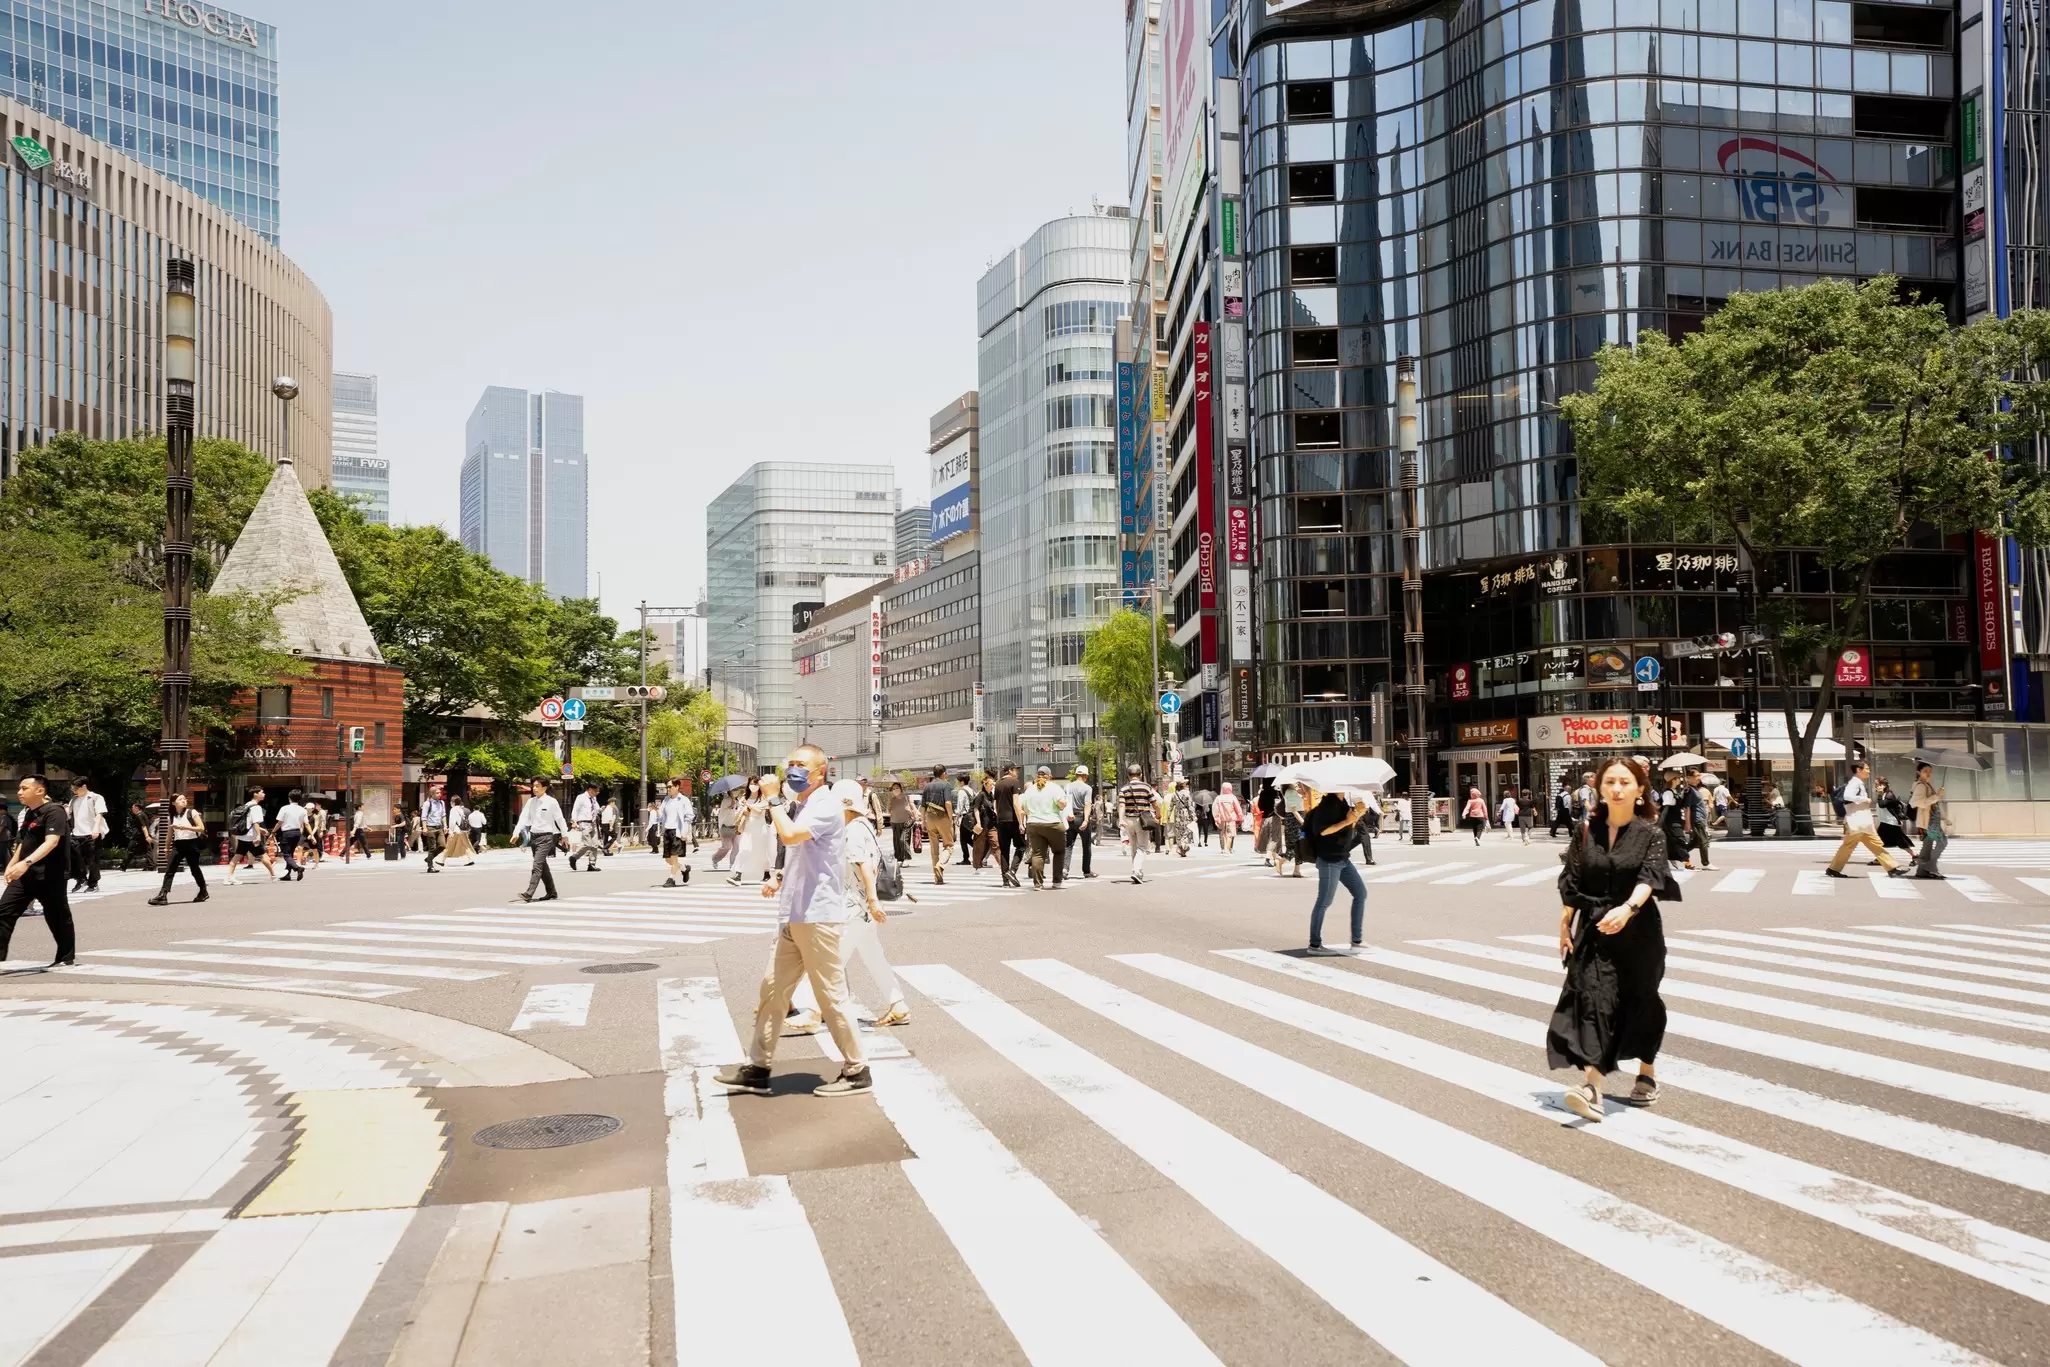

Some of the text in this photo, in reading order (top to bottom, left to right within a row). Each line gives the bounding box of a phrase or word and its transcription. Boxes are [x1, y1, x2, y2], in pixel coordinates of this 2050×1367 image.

[1196, 333, 1209, 401] カラオケ
[1230, 449, 1243, 495] 星乃珈琲店
[939, 498, 970, 530] 木下の介護
[1238, 519, 1247, 550] 不二家
[1200, 532, 1213, 592] BIG ECHO
[1656, 553, 1738, 573] 星乃珈琲
[1480, 563, 1535, 594] 星乃珈琲店
[1541, 580, 1560, 588] HAND
[1547, 585, 1572, 593] COFFEE
[1982, 547, 1996, 651] REGAL SHOES
[1235, 600, 1247, 636] 不二家
[1544, 659, 1579, 669] ハンバーグ
[1842, 666, 1862, 674] 不二家
[1549, 672, 1574, 682] 不二家
[1838, 674, 1867, 682] レストラン
[1561, 716, 1628, 731] Peko cha
[1566, 732, 1613, 744] House
[243, 748, 297, 758] KOBAN
